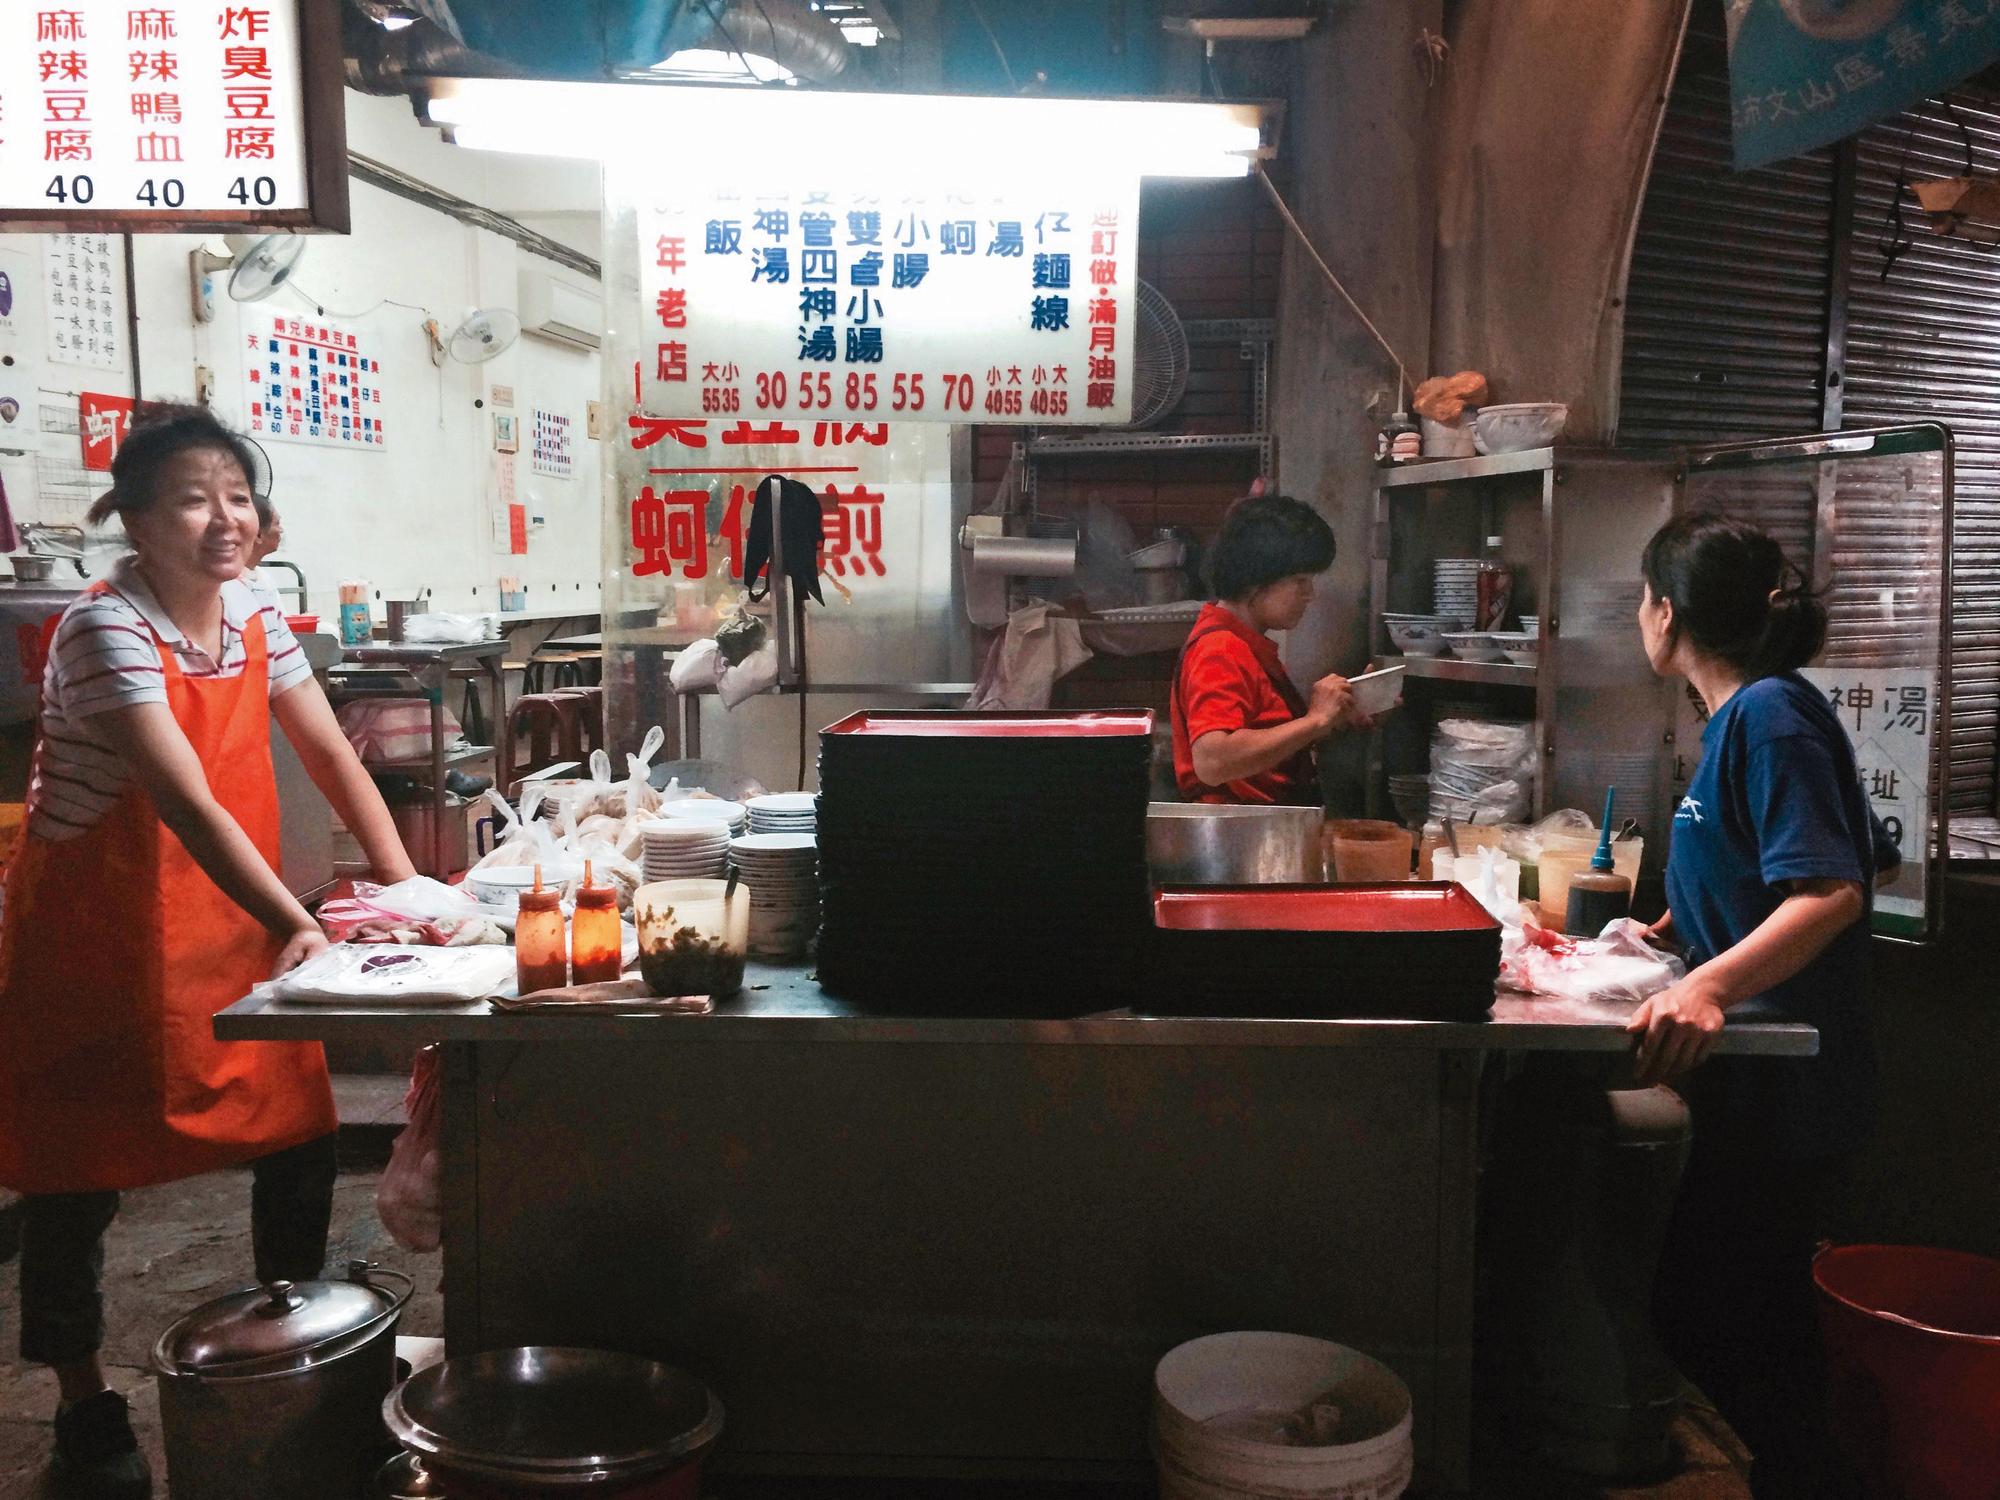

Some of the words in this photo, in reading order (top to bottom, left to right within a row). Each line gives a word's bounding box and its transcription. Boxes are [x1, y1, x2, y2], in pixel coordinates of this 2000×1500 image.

[37, 10, 92, 161] 麻辣豆腐
[127, 9, 184, 162] 麻辣鴨血
[217, 7, 275, 159] 炸臭豆腐
[46, 174, 94, 204] 40
[136, 178, 184, 207] 40
[228, 176, 276, 205] 40
[751, 194, 789, 284] 神湯
[845, 194, 885, 363] 雙管小腸
[892, 195, 930, 289] 小腸
[756, 371, 787, 409] 30
[799, 372, 831, 410] 55
[845, 372, 878, 411] 85
[892, 373, 924, 411] 55
[943, 373, 974, 412] 70
[1830, 681, 1927, 736] 神湯
